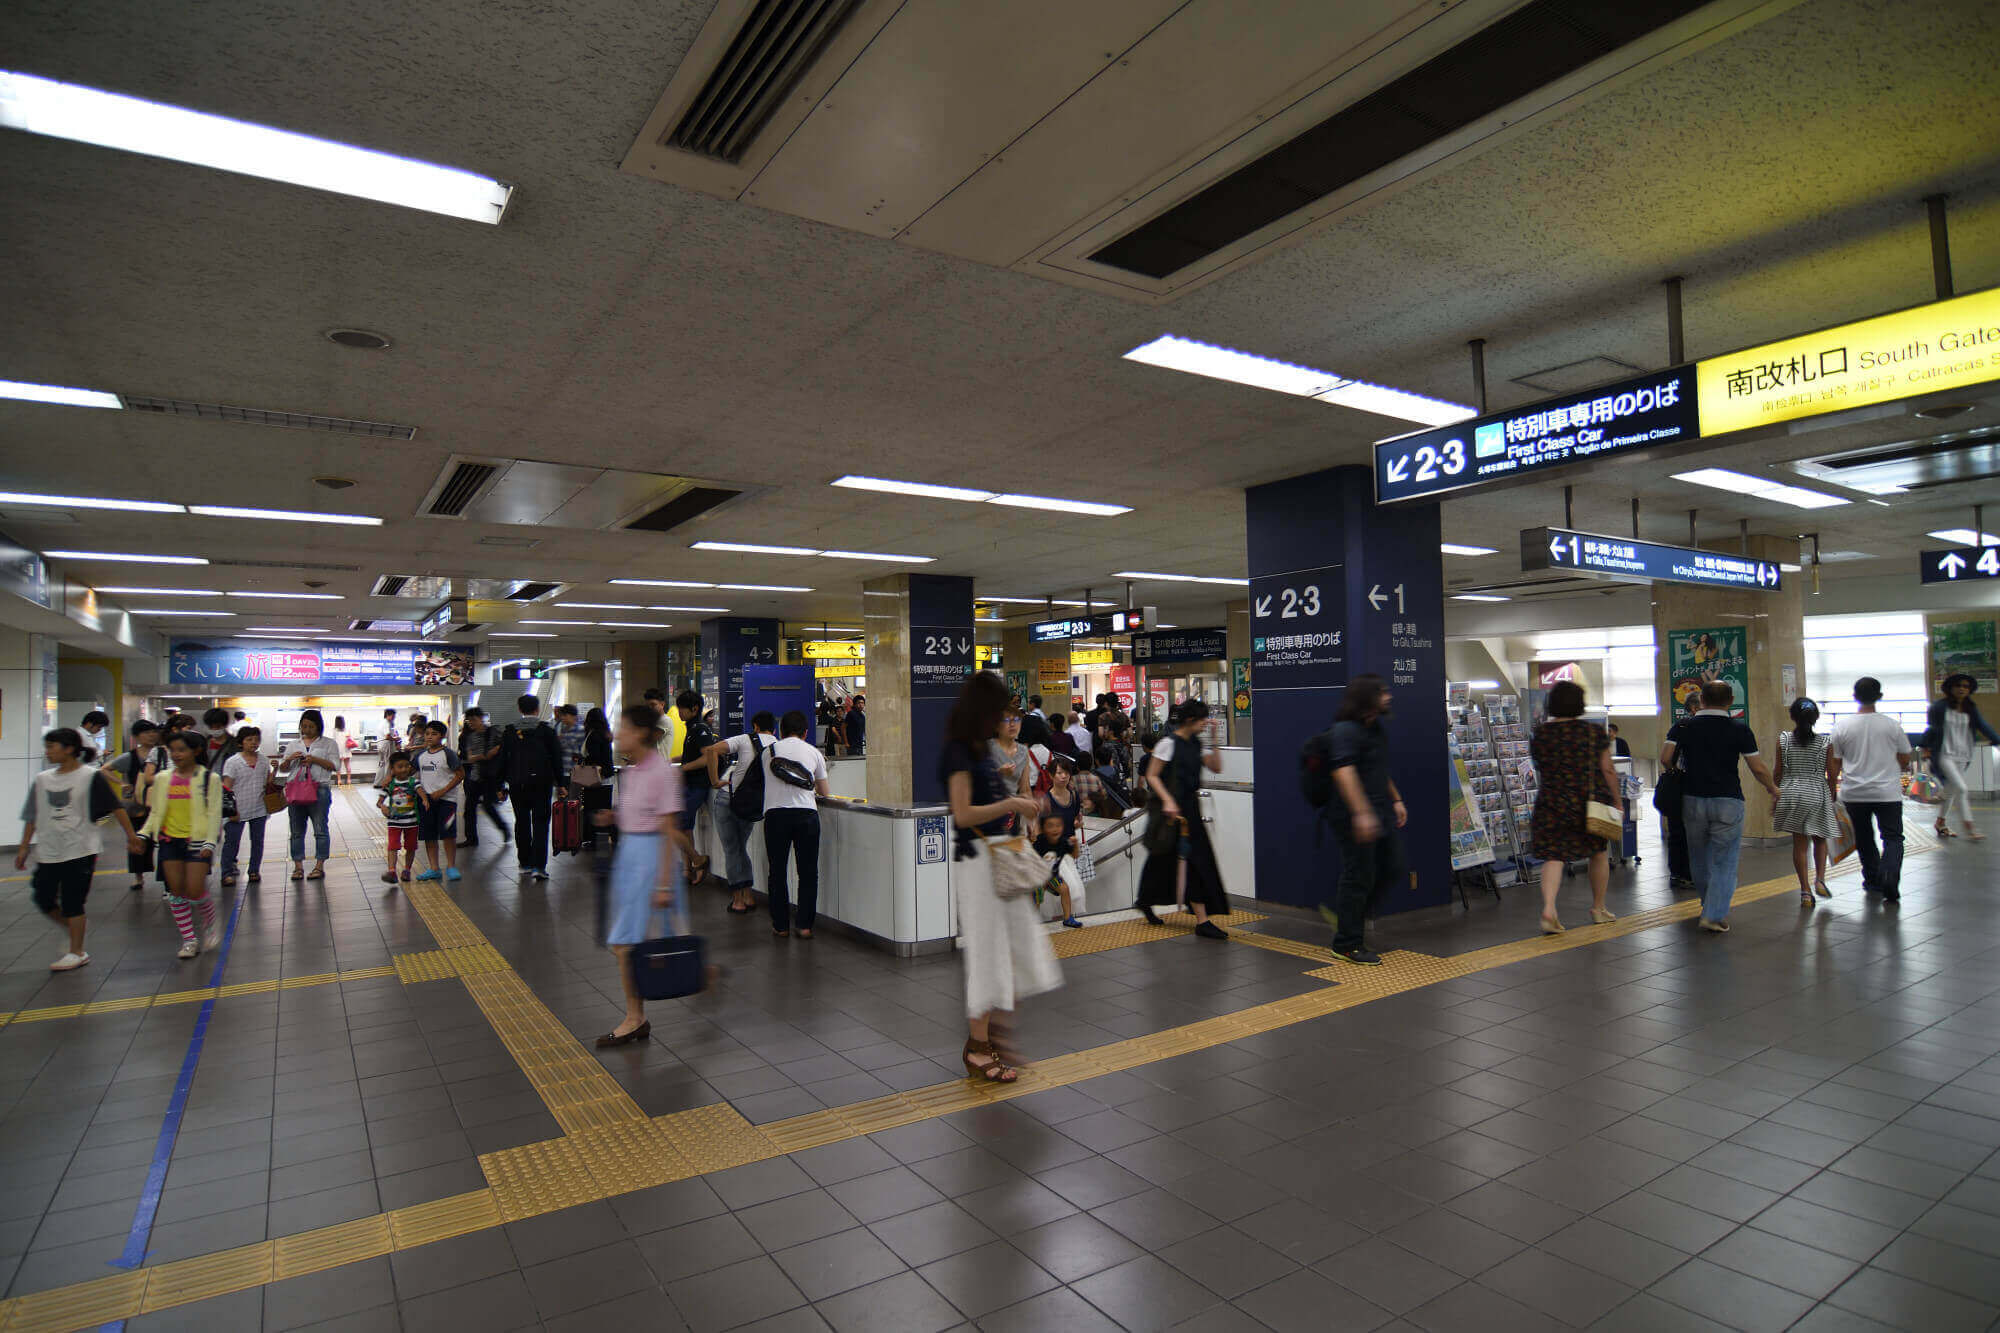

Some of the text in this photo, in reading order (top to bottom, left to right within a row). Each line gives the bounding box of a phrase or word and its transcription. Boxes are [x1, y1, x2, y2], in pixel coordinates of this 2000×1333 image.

[1860, 327, 2000, 369] South Gate
[1725, 347, 1848, 400] 南改札口
[1506, 379, 1680, 443] 特別車専用のりば
[1507, 428, 1603, 459] First Class Car
[1612, 433, 1649, 447] Primeira
[1649, 426, 1680, 440] Classe
[1569, 536, 1579, 566] 1
[1976, 548, 2000, 576] 4
[1757, 562, 1765, 587] 4
[1394, 583, 1404, 614] 1
[749, 646, 759, 660] 4
[1266, 631, 1341, 651] 特別車専用のりば
[1266, 650, 1312, 661] First Class Car
[1554, 665, 1572, 682] 4
